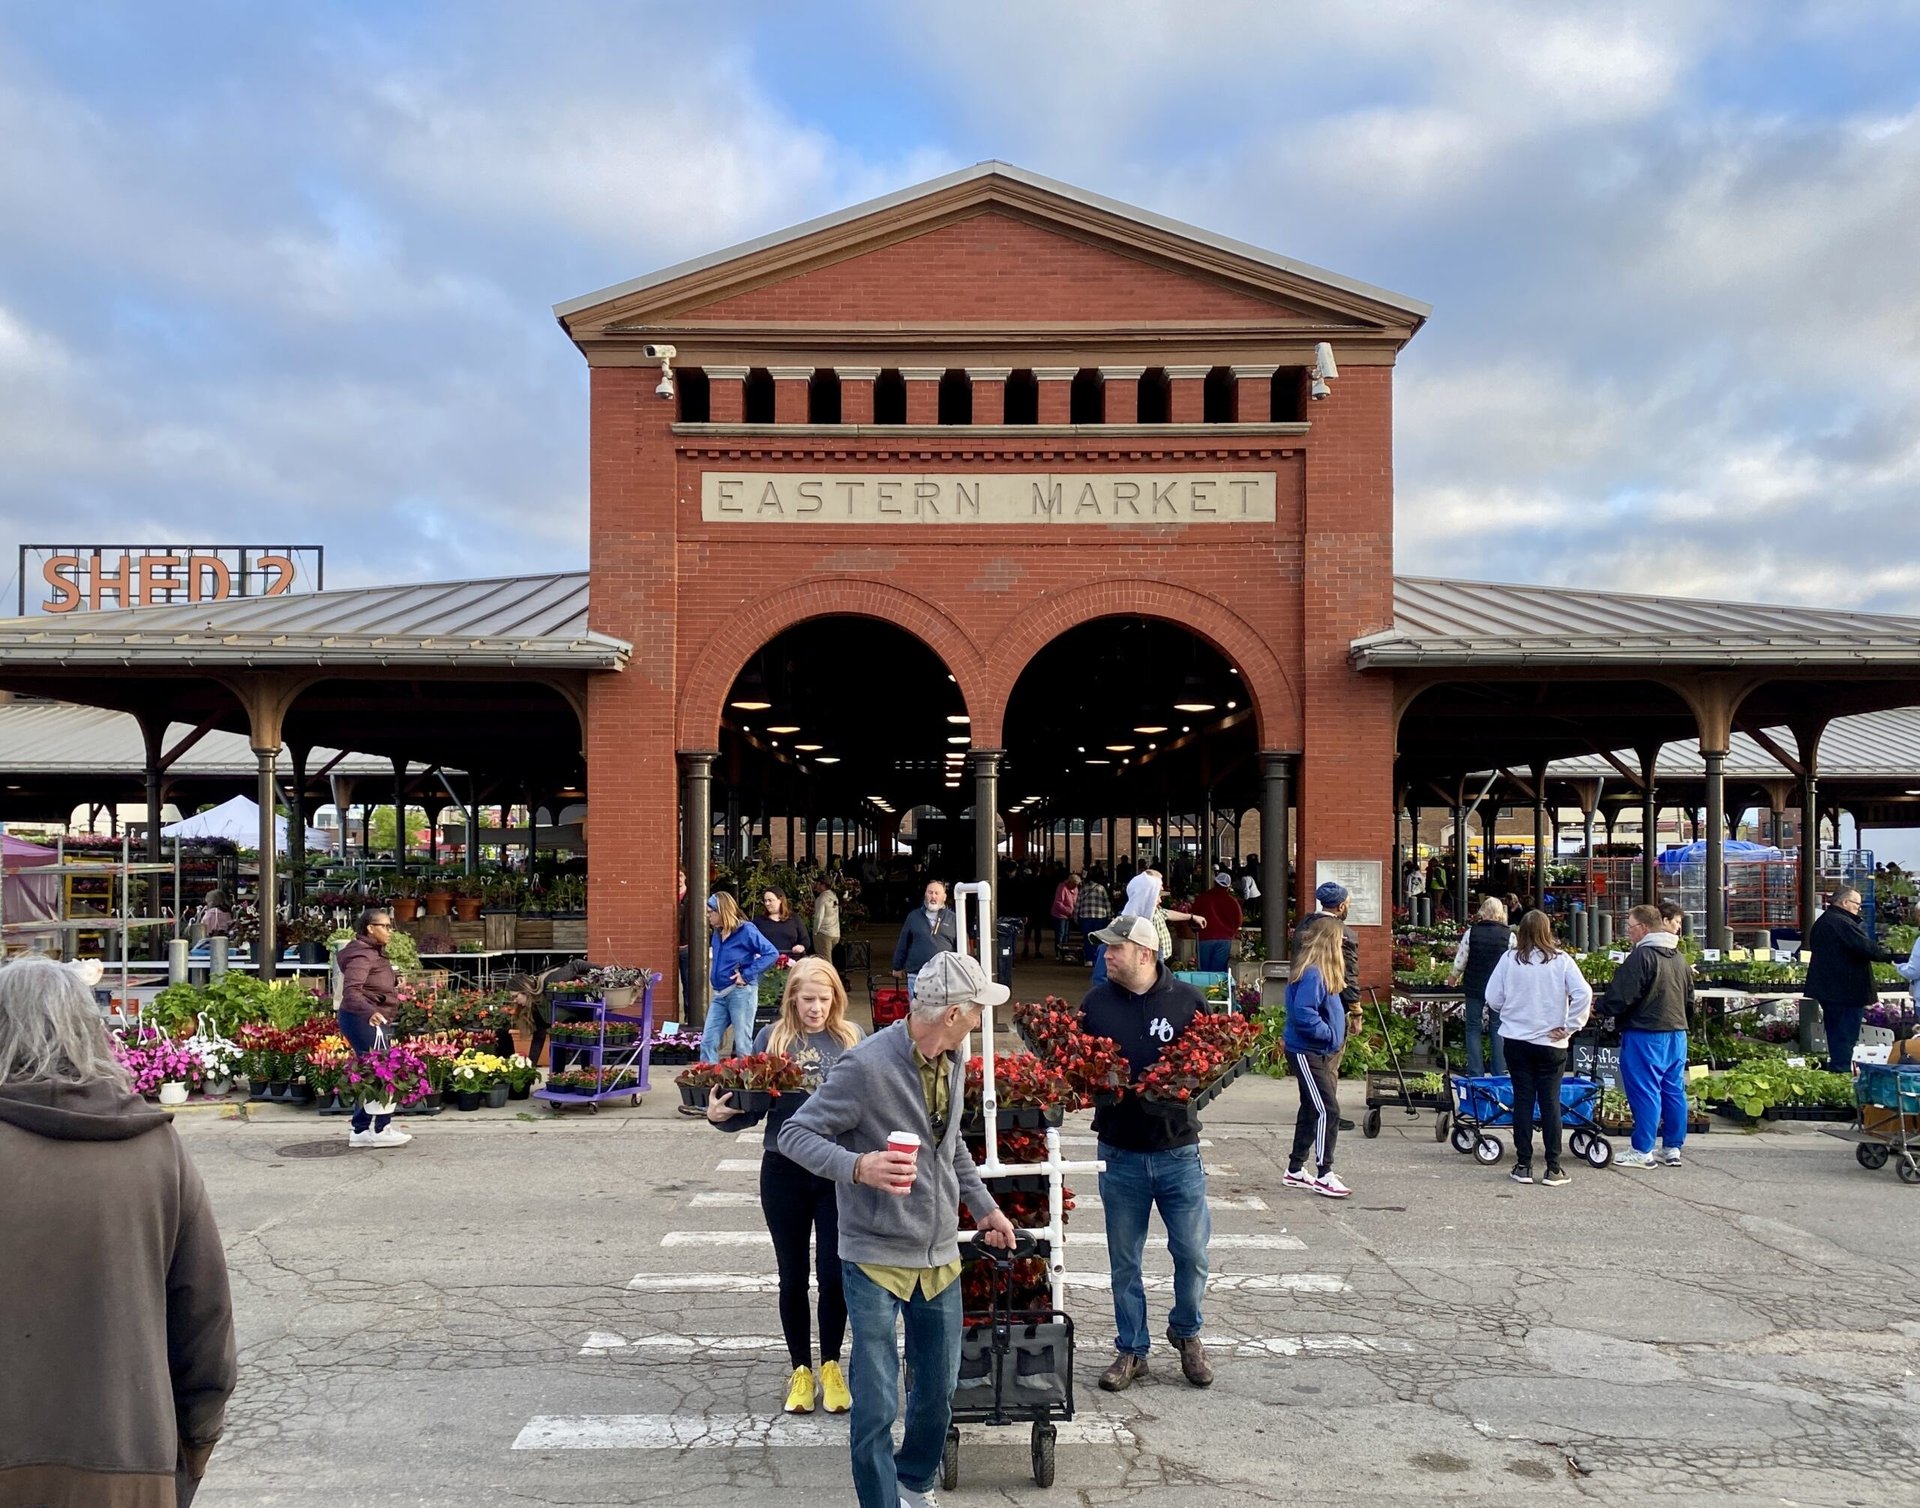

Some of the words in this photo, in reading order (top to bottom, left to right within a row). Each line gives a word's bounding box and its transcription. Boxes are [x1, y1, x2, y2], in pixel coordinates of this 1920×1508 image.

[718, 480, 980, 515] EASTERN
[1031, 480, 1260, 515] MARKET
[42, 555, 230, 612] SHED
[257, 555, 295, 596] 2
